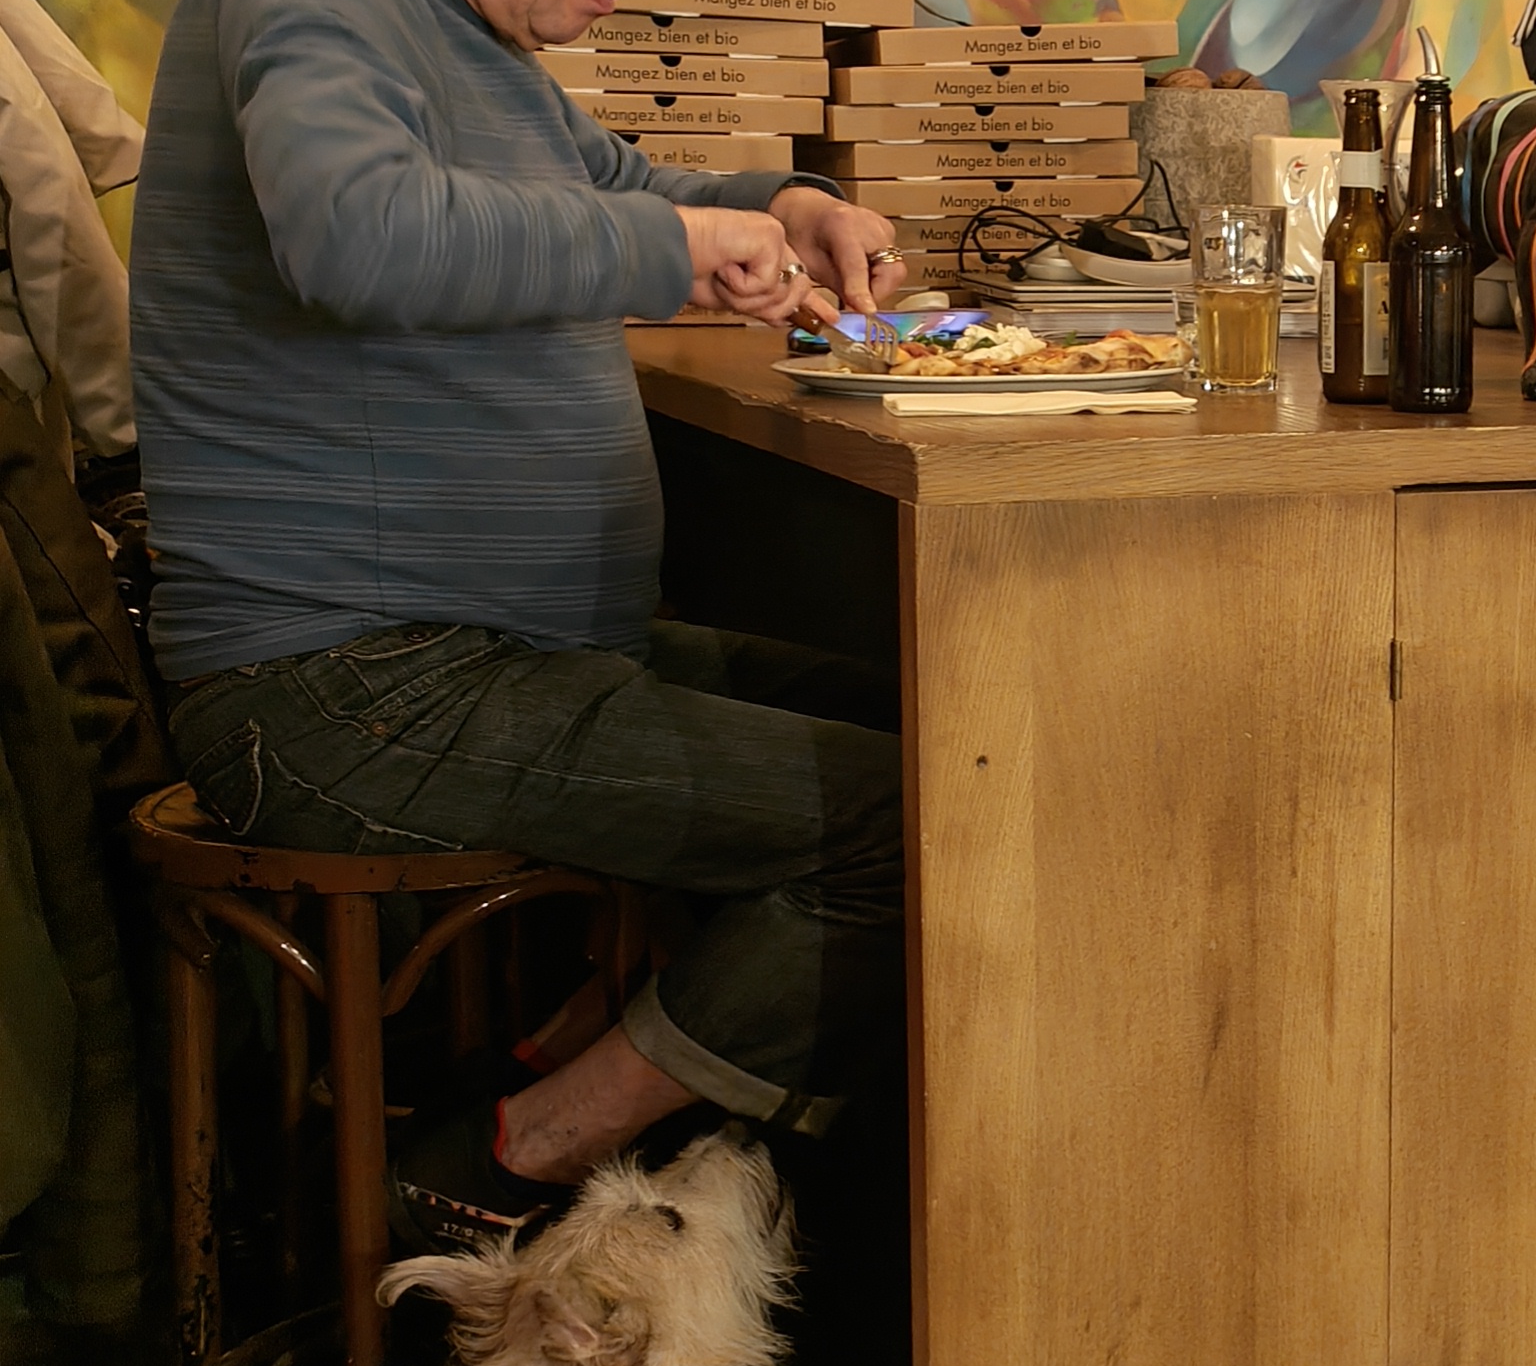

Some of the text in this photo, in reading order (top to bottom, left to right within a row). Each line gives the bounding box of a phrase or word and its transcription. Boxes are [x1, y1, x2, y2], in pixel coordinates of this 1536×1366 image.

[588, 26, 739, 46] Mangez bien et bio
[964, 35, 1102, 56] Mangez bien et bio
[595, 65, 745, 83] Mangez bien et bio
[934, 81, 1070, 98] Mangez bien et bio
[592, 107, 742, 125] Mangez bien et bio
[919, 118, 1054, 135] Mangez bien et bio
[664, 150, 677, 163] et
[682, 148, 708, 164] bio
[936, 153, 1067, 171] Mangez bien et bio
[940, 194, 1071, 211] Mangez bien et bio
[982, 227, 1012, 240] bien
